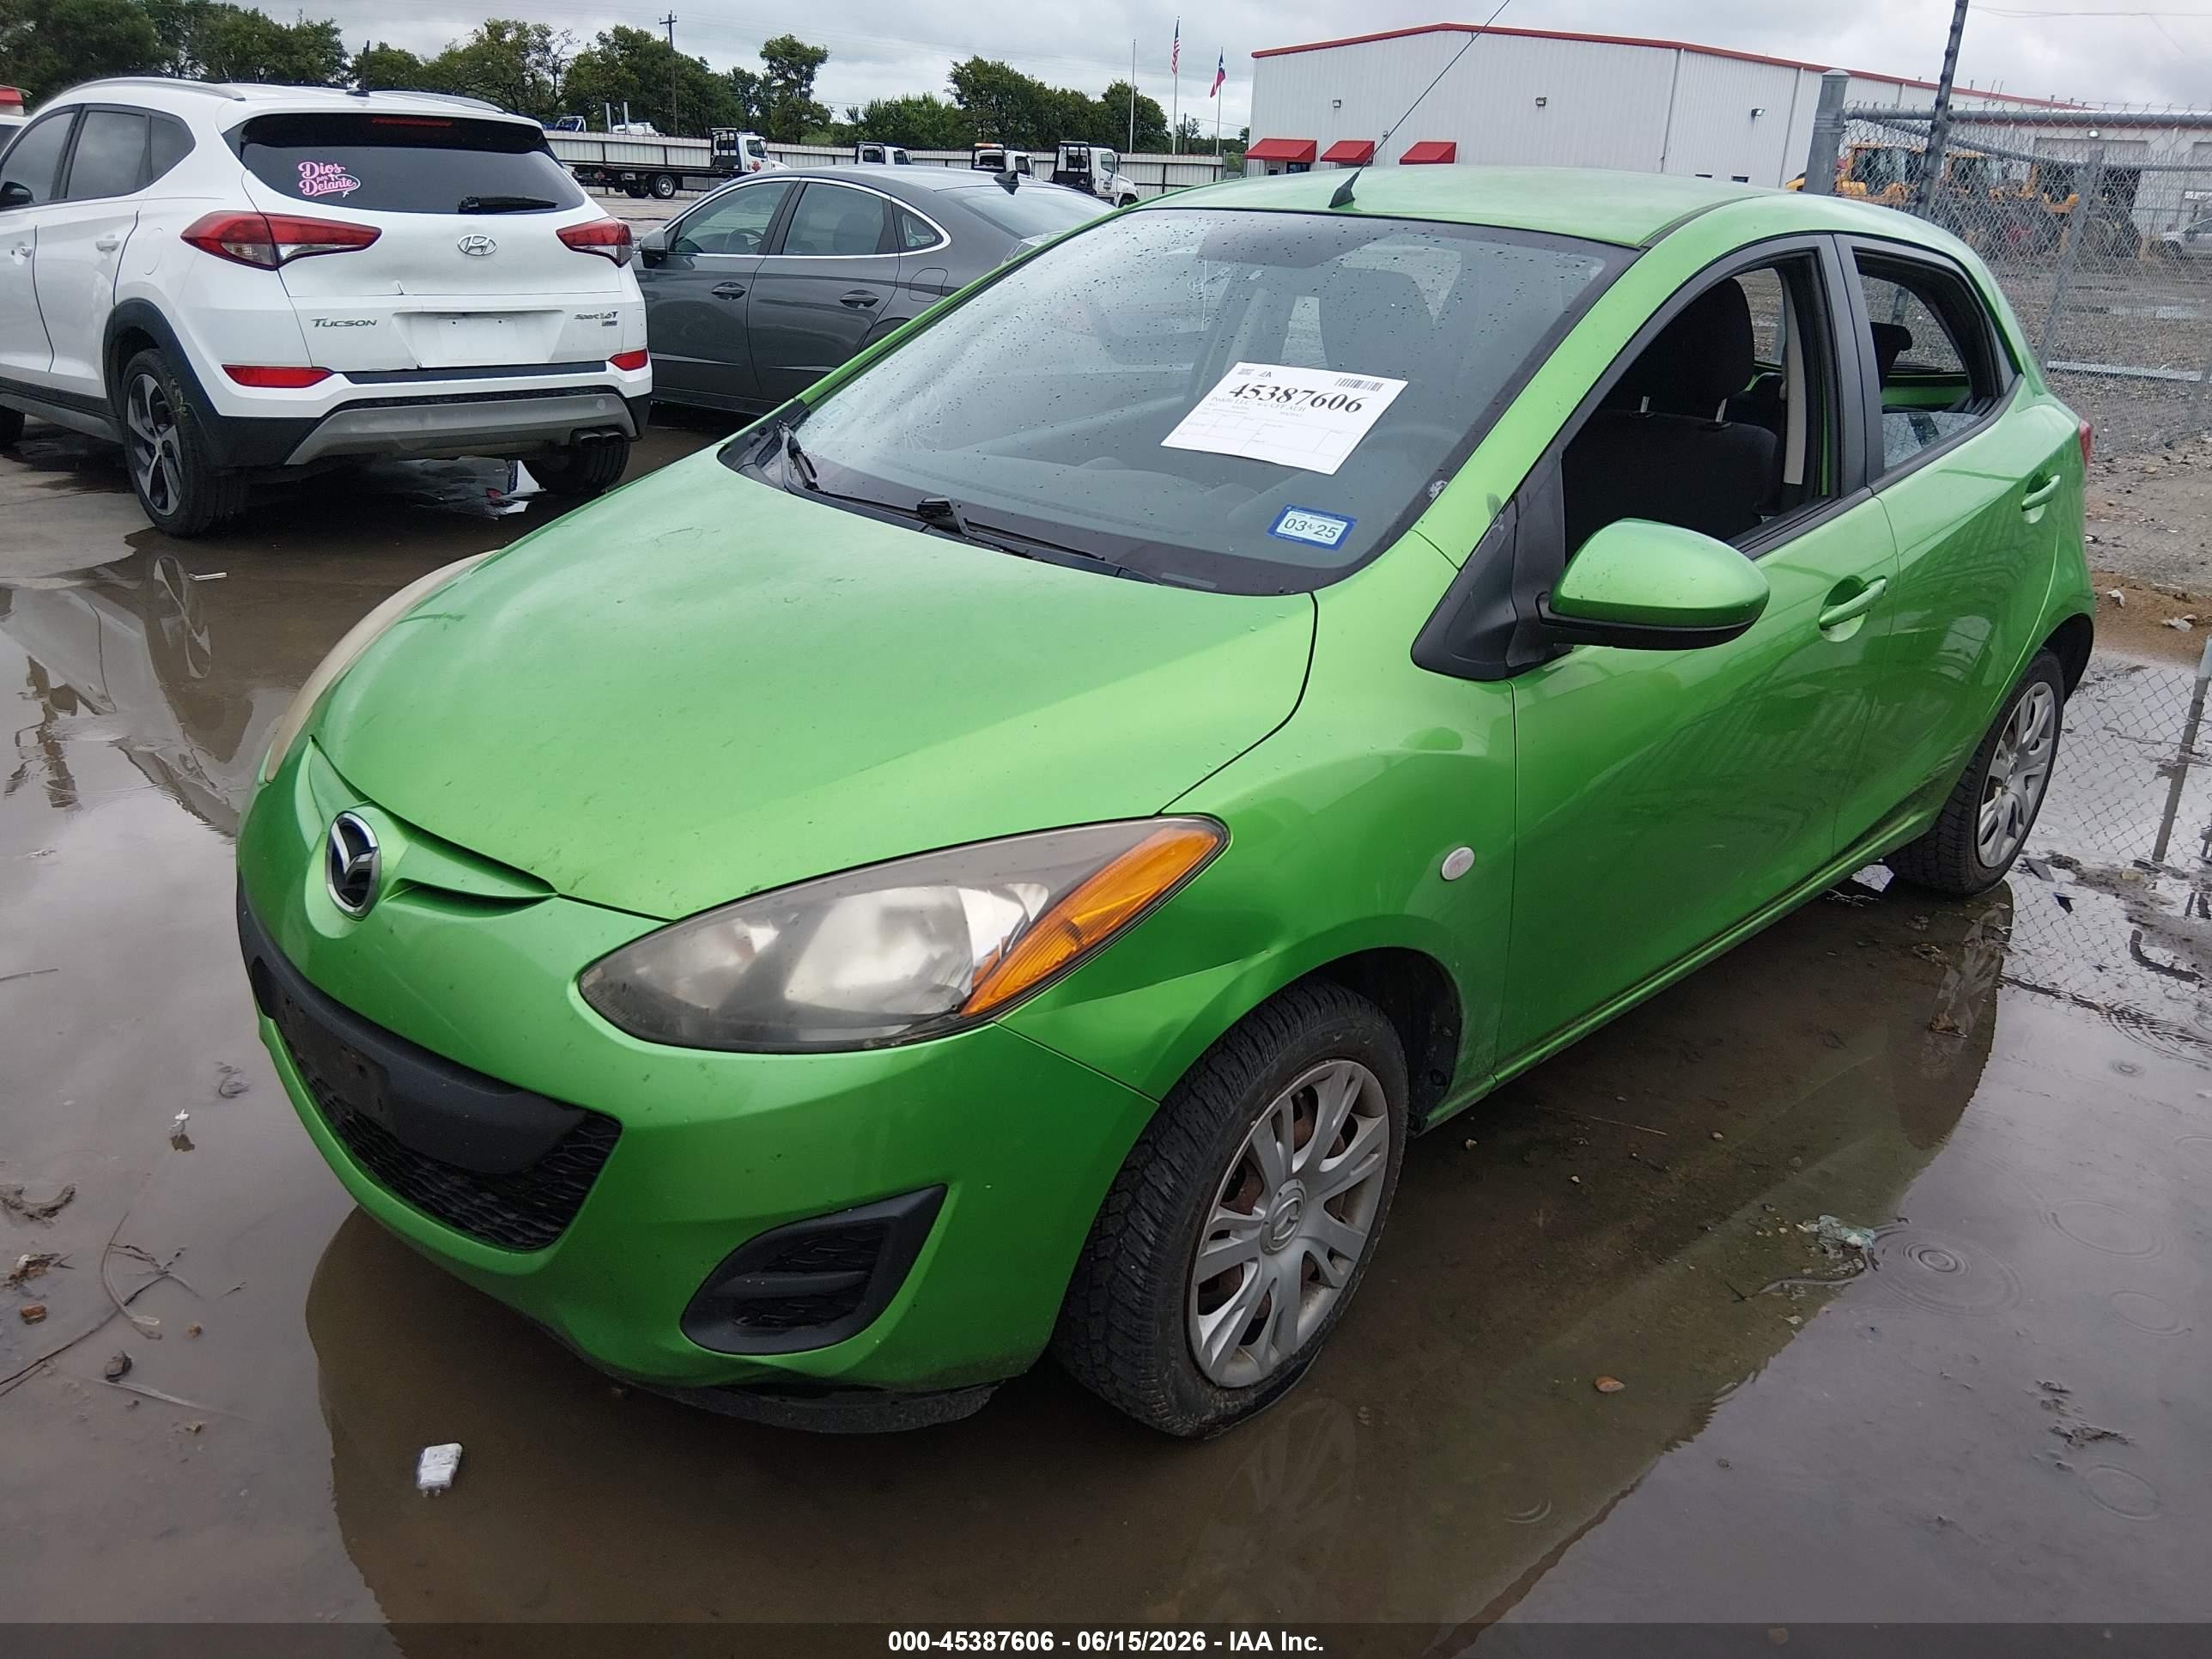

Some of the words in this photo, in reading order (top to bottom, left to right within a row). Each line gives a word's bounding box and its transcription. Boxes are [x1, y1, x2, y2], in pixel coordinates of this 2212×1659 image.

[298, 161, 345, 179] Dios
[299, 178, 357, 197] Delante
[1229, 383, 1370, 414] 45387606
[1284, 518, 1308, 532] 03
[1313, 524, 1340, 539] 25
